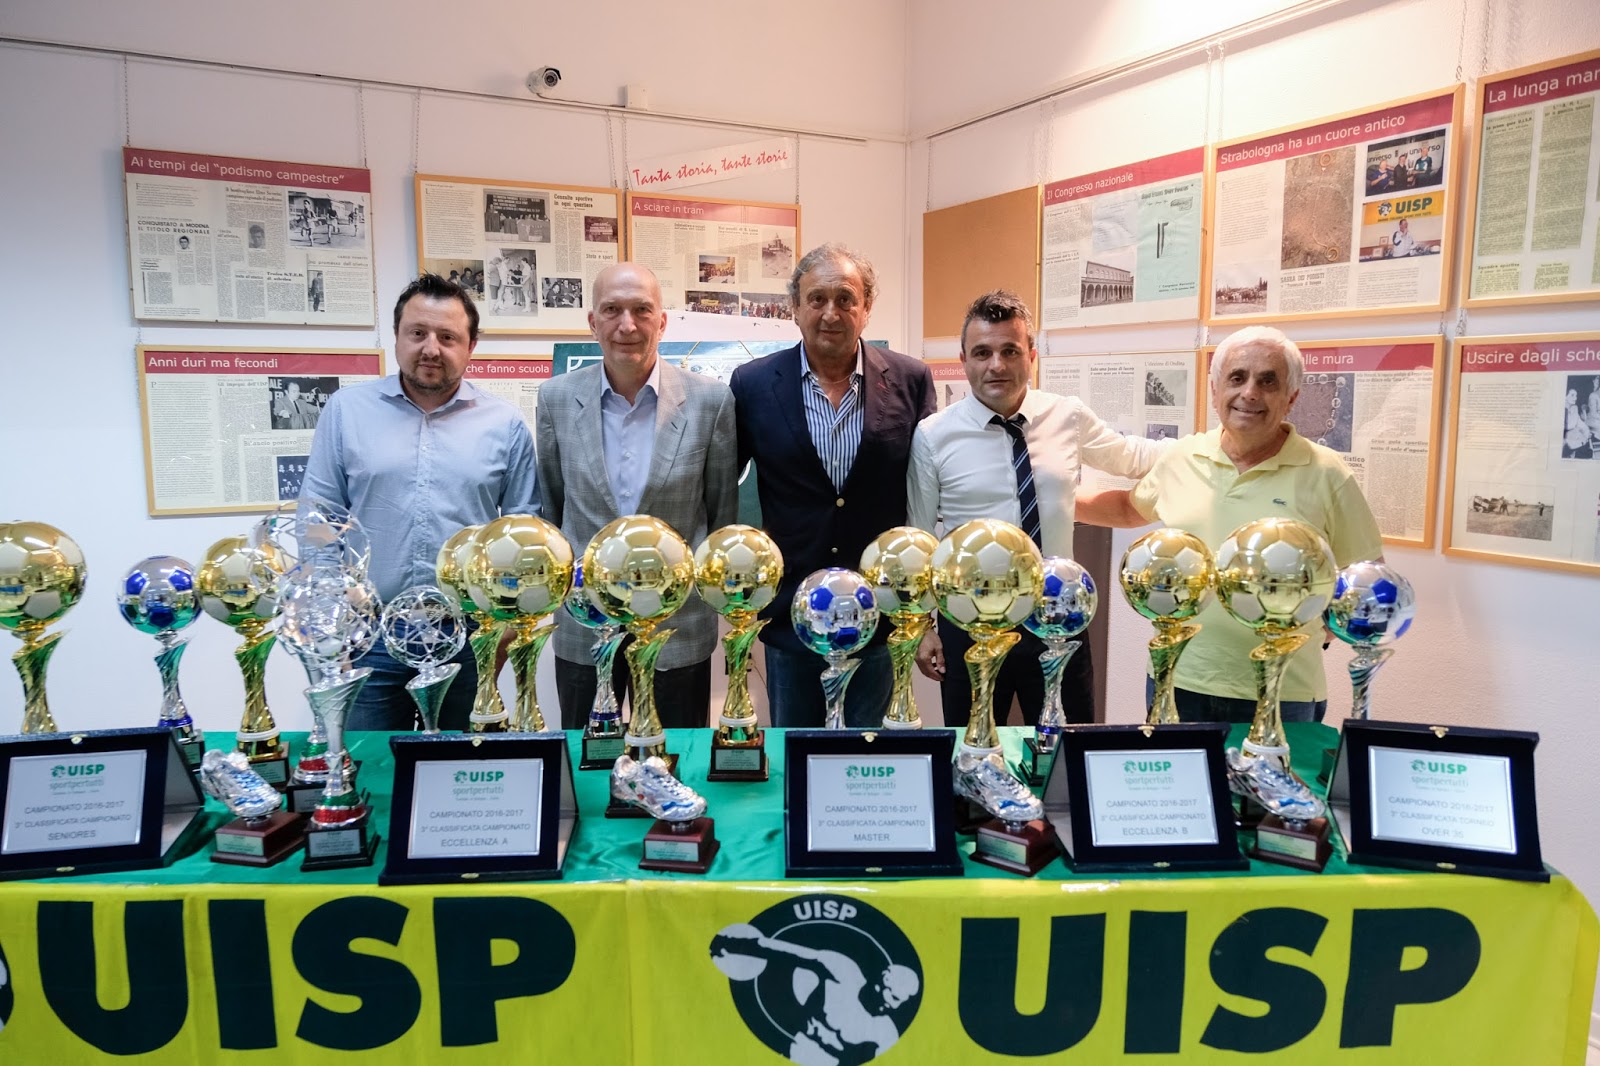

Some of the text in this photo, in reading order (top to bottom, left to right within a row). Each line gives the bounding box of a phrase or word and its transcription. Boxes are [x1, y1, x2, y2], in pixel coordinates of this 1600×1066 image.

[1489, 90, 1506, 104] La
[1513, 78, 1559, 99] lunga
[1220, 115, 1406, 165] Strabologna ha un cuore antico
[131, 156, 144, 167] Ai
[148, 158, 186, 172] tempi
[190, 163, 209, 174] del
[633, 149, 788, 186] Tanta storia, tante storie
[1054, 182, 1093, 198] Congresso
[1095, 172, 1134, 189] nazionale
[634, 202, 705, 215] A sciare in tram
[1395, 197, 1433, 214] UISP
[148, 357, 278, 369] Anni duri ma fecondi
[1322, 354, 1354, 365] mura
[1466, 351, 1514, 364] Uscire
[1520, 348, 1560, 366] dagli
[466, 363, 550, 374] che fanno scuola
[67, 763, 105, 777] UISP
[860, 766, 895, 778] UISP
[1137, 760, 1172, 772] UISP
[1428, 761, 1468, 775] UISP
[469, 770, 504, 782] UISP
[1124, 775, 1175, 786] sportpertutti
[1411, 775, 1469, 788] sportpertutti
[453, 785, 504, 796] sportpertutti
[845, 780, 896, 792] sportpertutti
[24, 800, 125, 815] CAMPIONATO 2016-2017
[824, 804, 917, 813] CAMPIONATO 2016-2017
[1106, 798, 1198, 808] CAMPIONATO 2016-2017
[1388, 796, 1449, 809] CAMPIONATO
[429, 809, 524, 819] CAMPIONATO 2016-2017
[1108, 814, 1159, 822] CLASSIFICATA
[1159, 812, 1207, 821] CAMPIONATO
[1399, 811, 1457, 823] CLASSIFICATA
[1458, 816, 1495, 827] TORNEO
[24, 817, 80, 829] CLASSIFICATA
[80, 814, 132, 824] CAMPIONATO
[826, 819, 877, 827] CLASSIFICATA
[878, 819, 926, 827] CAMPIONATO
[430, 824, 481, 833] CLASSIFICATA
[481, 823, 531, 831] CAMPIONATO
[1122, 827, 1189, 836] ECCELLENZA B
[1421, 826, 1465, 839] OVER 35
[47, 829, 96, 841] SENIORES
[853, 833, 890, 842] MASTER
[440, 838, 509, 848] ECCELLENZA A
[793, 900, 857, 921] UISP
[37, 895, 577, 1056] UISP
[957, 907, 1482, 1057] UISP
